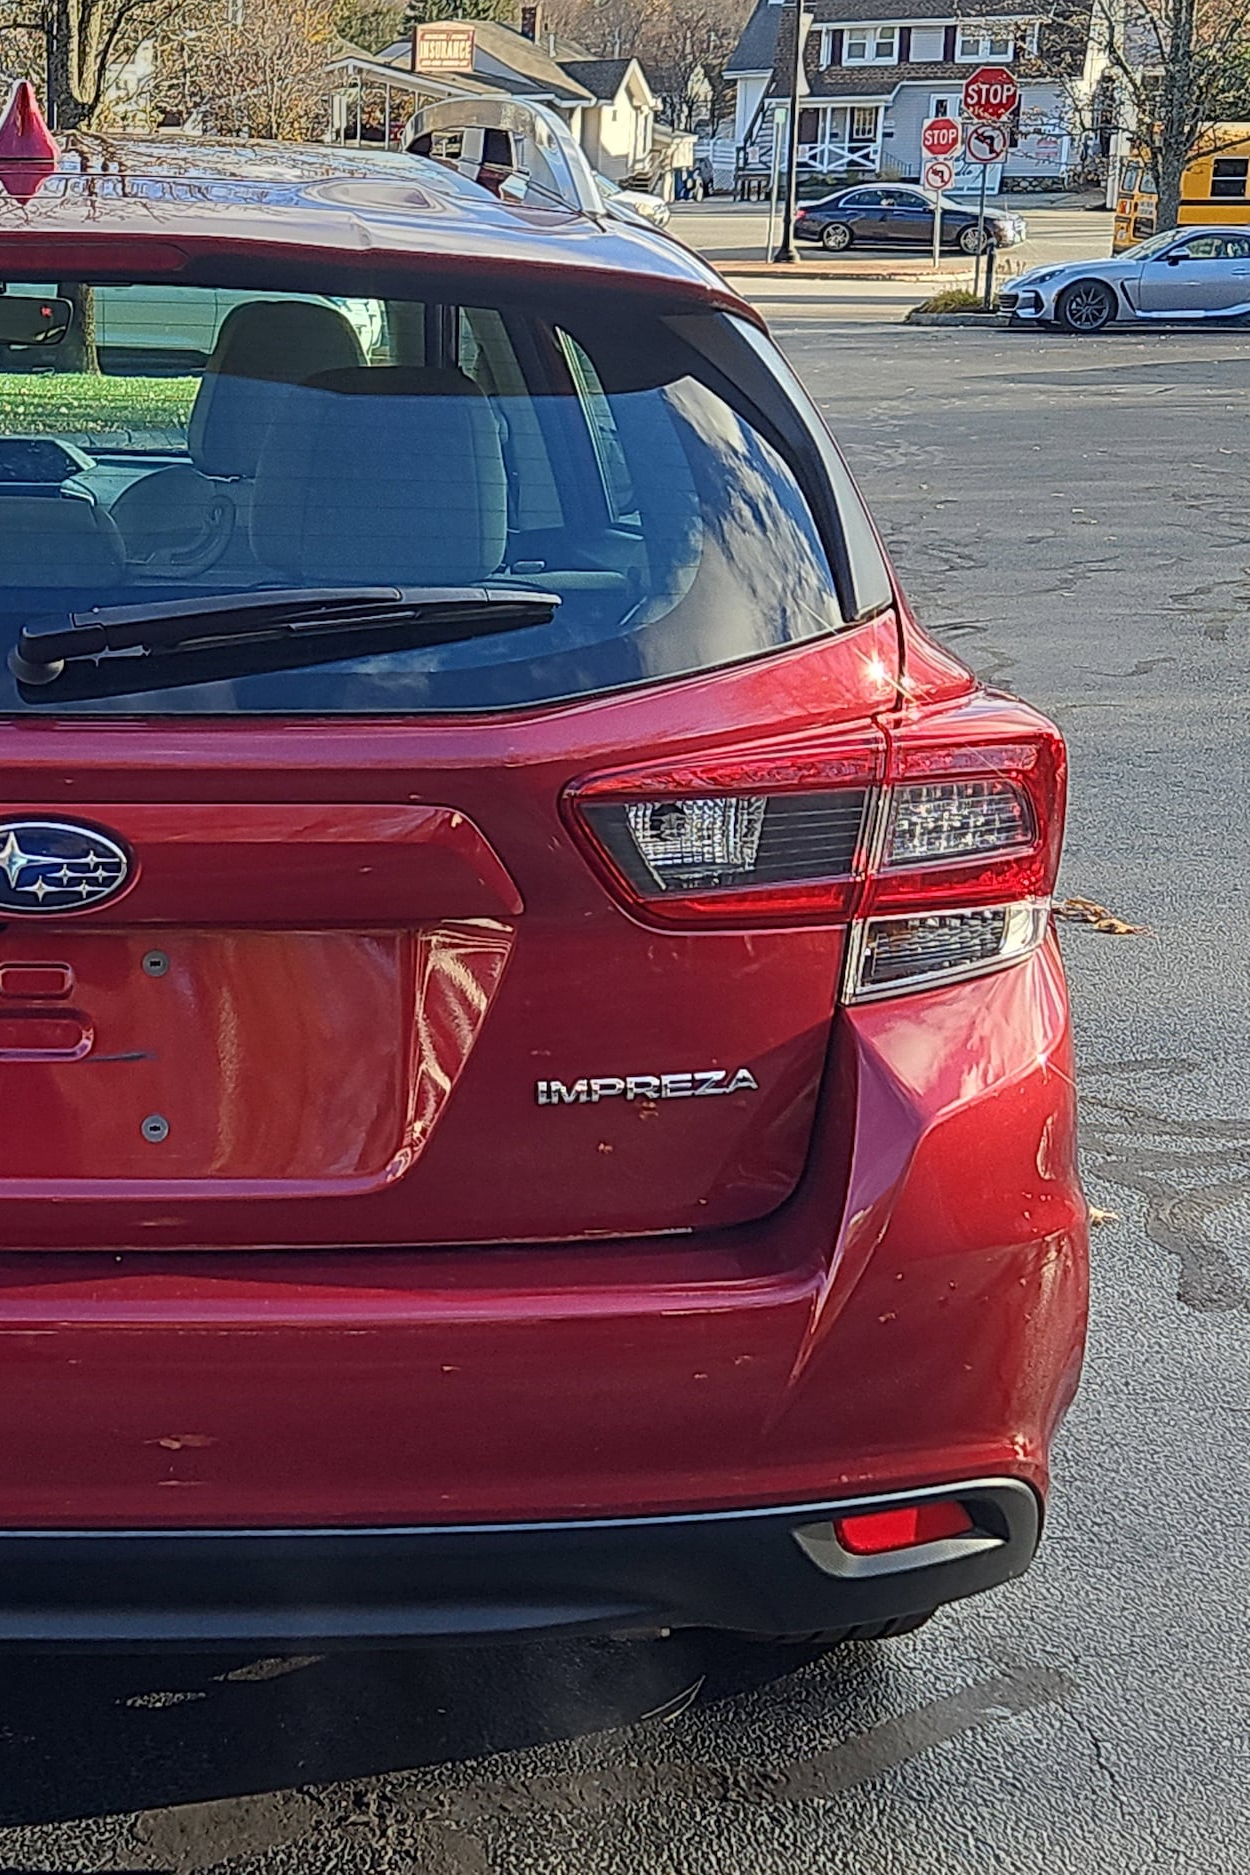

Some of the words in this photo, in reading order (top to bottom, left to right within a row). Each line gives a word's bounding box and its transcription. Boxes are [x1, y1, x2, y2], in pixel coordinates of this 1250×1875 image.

[419, 40, 472, 60] INSURANCE
[966, 83, 1015, 105] STOP
[924, 128, 958, 146] STOP
[536, 1068, 759, 1105] IMPREZA
